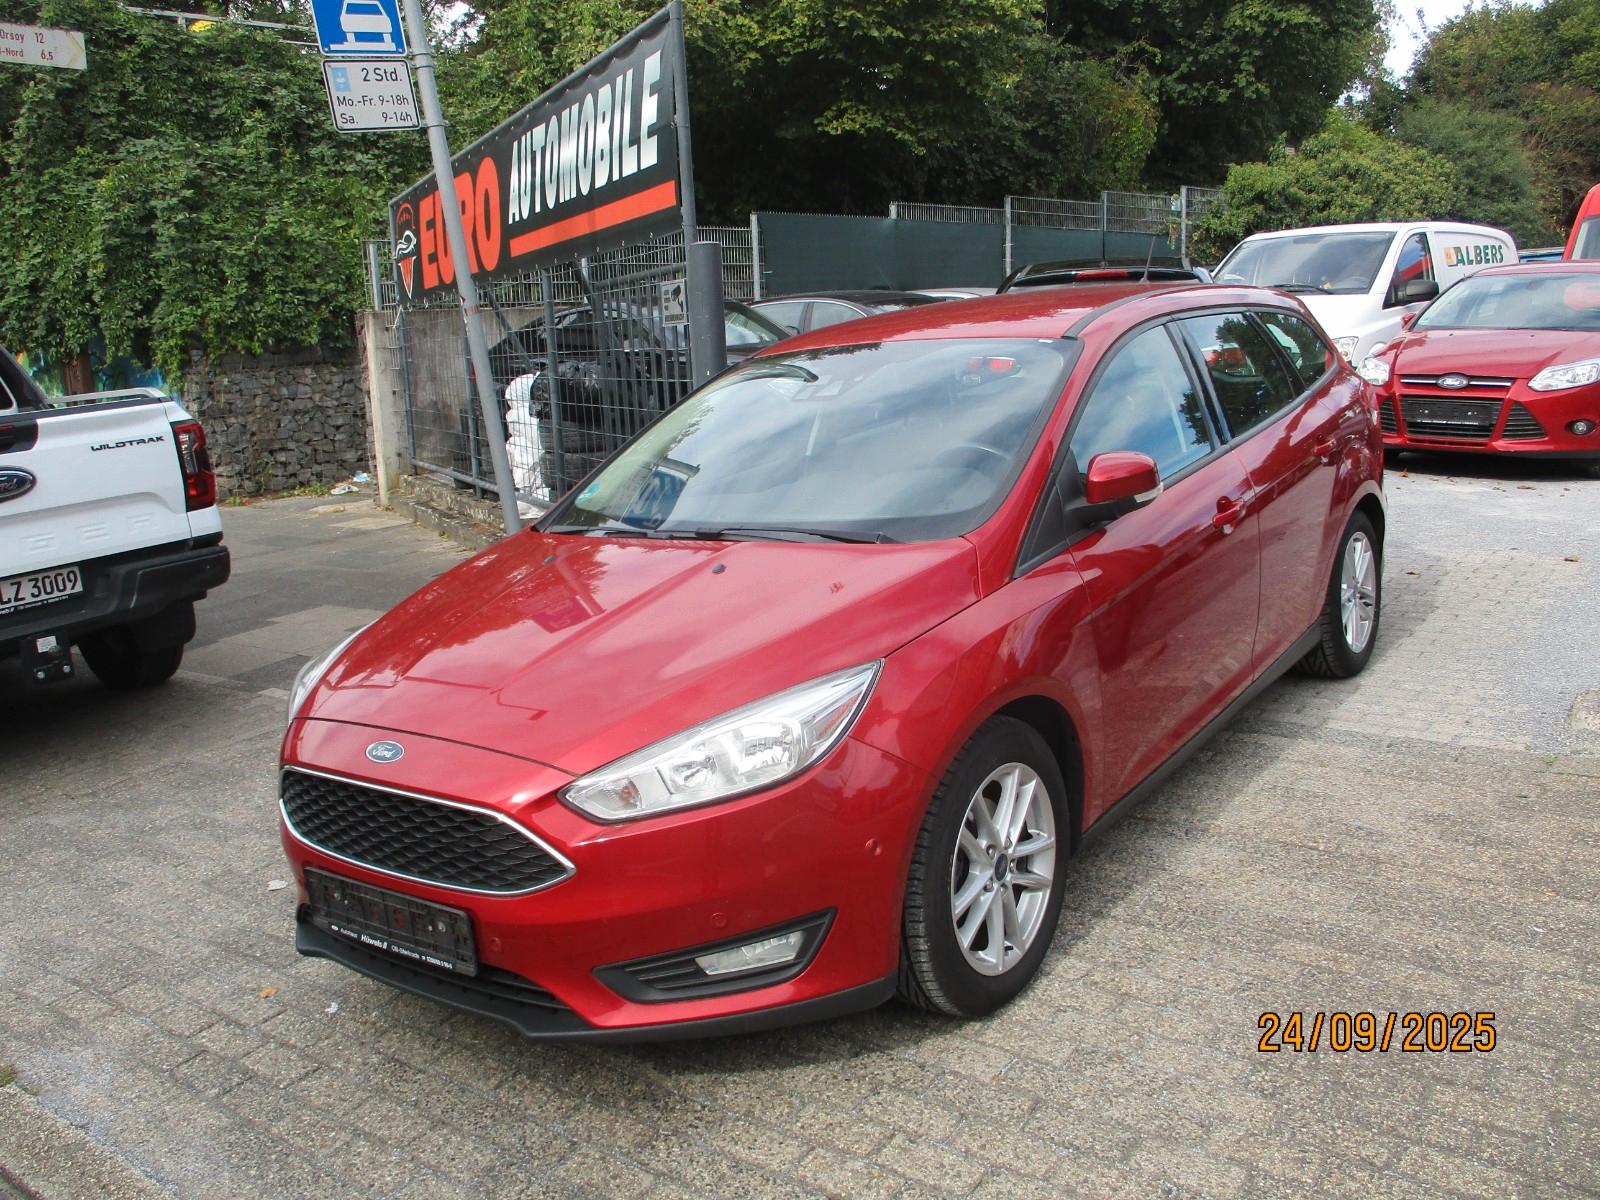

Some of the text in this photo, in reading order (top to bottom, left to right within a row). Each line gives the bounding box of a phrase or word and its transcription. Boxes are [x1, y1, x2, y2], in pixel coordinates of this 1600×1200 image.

[35, 32, 45, 44] 12
[0, 47, 54, 61] -Nord 6,5
[361, 67, 402, 82] 2 Std.
[336, 94, 410, 107] Mo.-Fr. 9-18h
[340, 111, 413, 125] Sa. 9-14h
[508, 50, 661, 225] AUTOMOBILE
[1454, 244, 1504, 267] ALBERS
[90, 435, 165, 452] WILDTRAK
[27, 570, 79, 598] 3009
